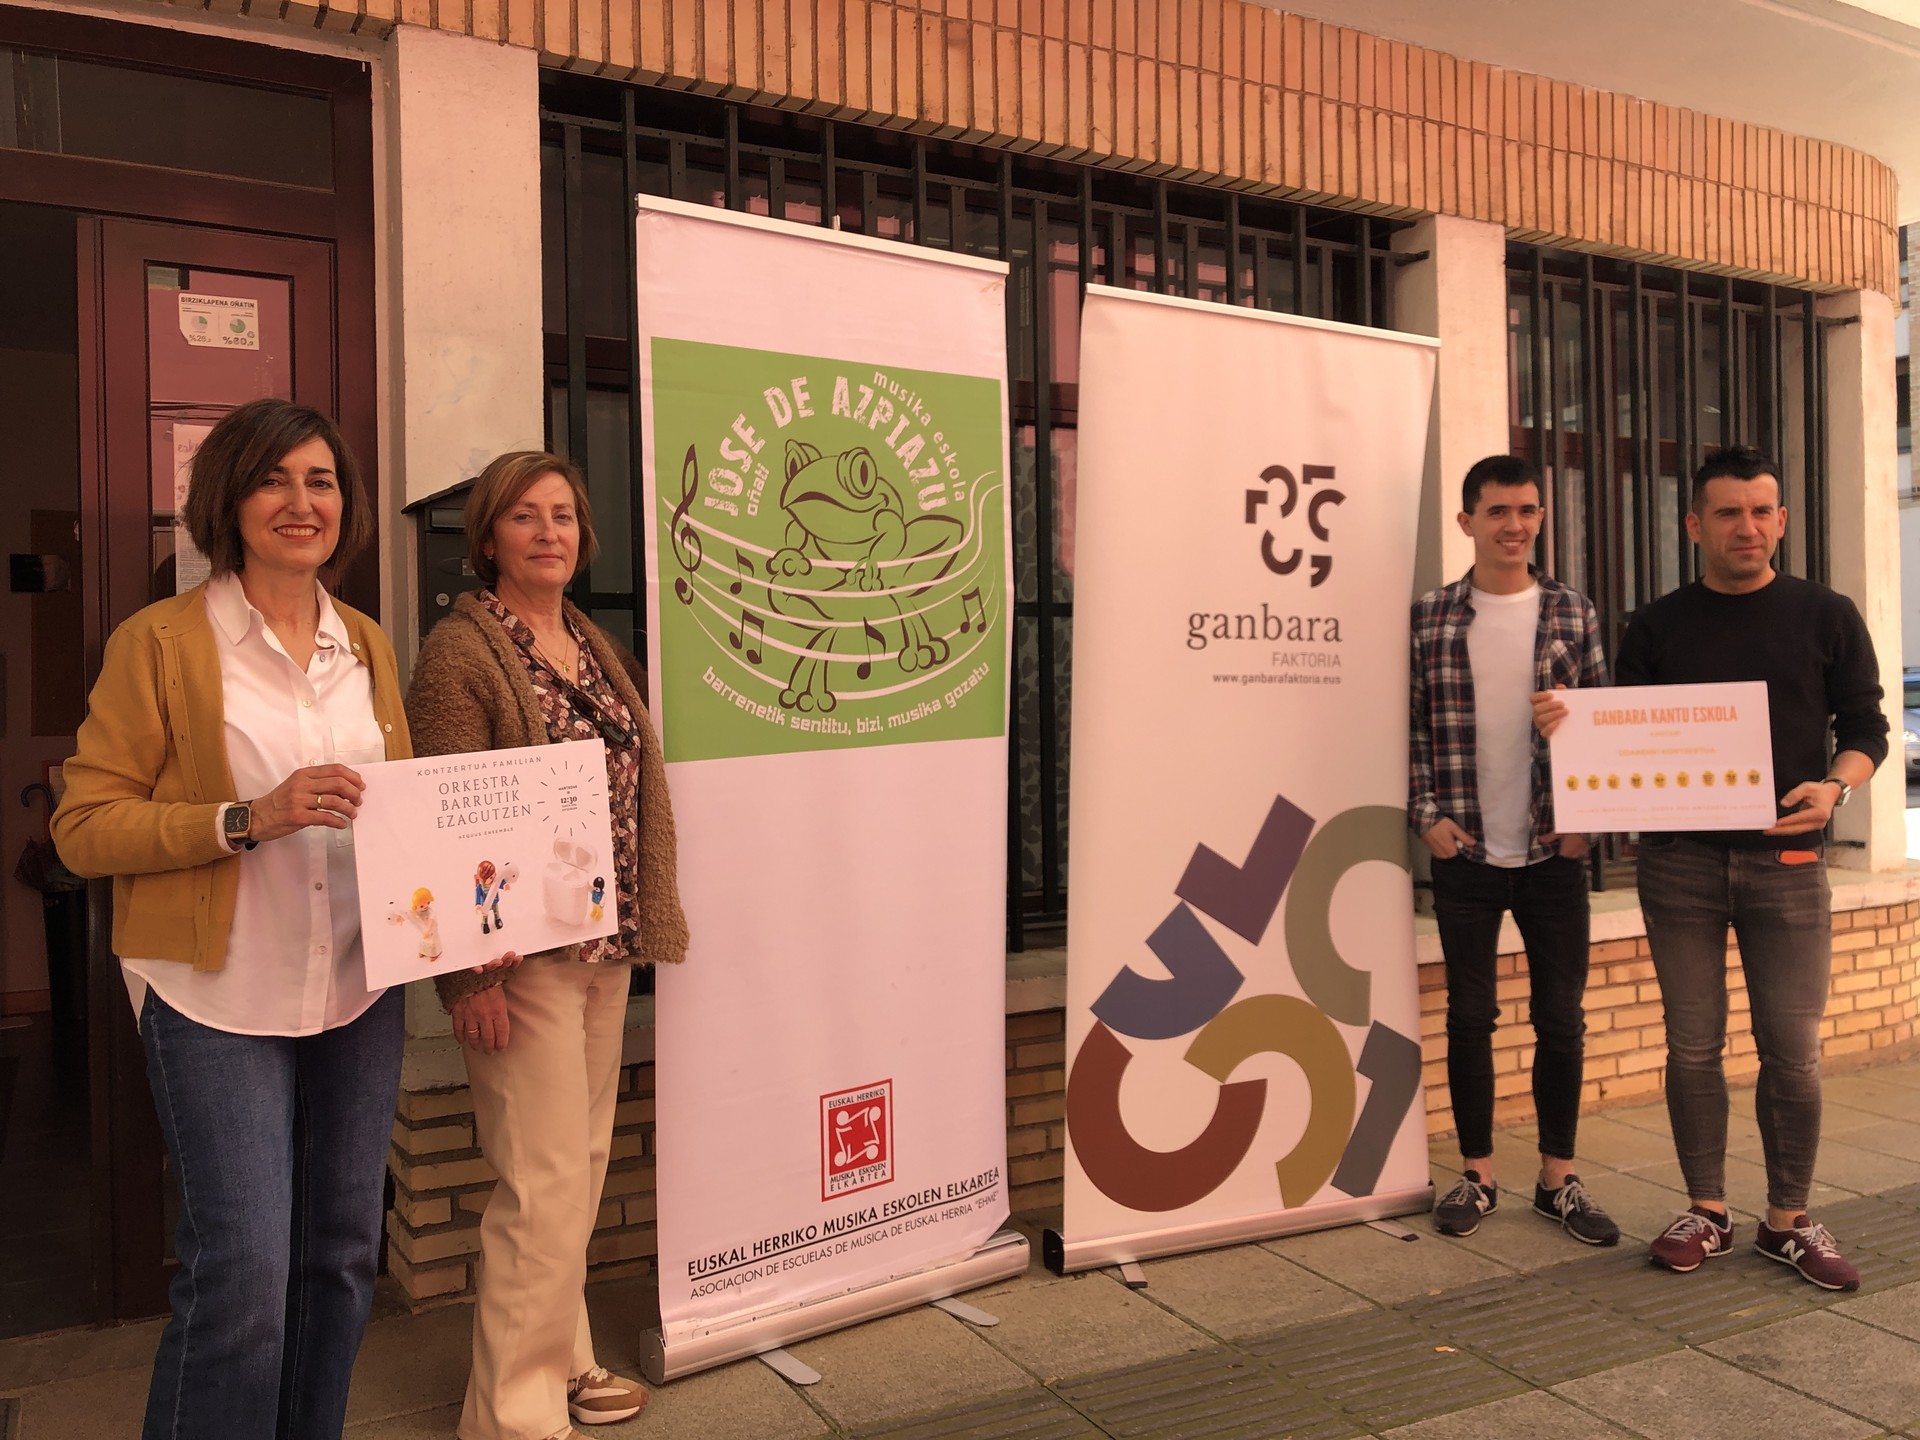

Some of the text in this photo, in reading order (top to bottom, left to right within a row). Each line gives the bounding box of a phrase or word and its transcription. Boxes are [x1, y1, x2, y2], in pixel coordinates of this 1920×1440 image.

[181, 297, 255, 308] BIRZIKLAPENA OÑATIN
[704, 376, 949, 517] JOSE DE AZPIAZU
[873, 371, 966, 501] musika eskola
[1186, 603, 1343, 650] ganbara
[1272, 652, 1341, 668] FAKTORIA
[1213, 673, 1341, 686] www.ganbarafaktoria.eus
[702, 662, 990, 735] barrenetik sentitu, bizi, musika gozatu
[1593, 705, 1737, 726] GANBARA KANTU ESKOLA
[417, 756, 542, 776] KONTZERTUA FAMILIAN
[438, 774, 520, 795] ORKESTRA
[441, 790, 520, 811] BARRUTIK
[437, 804, 531, 829] EZAGUTZEN
[484, 827, 513, 835] ENSEMBLE
[829, 1088, 885, 1108] EUSKAL HERRIKO
[830, 1162, 886, 1183] MUSIKA ESKOLEN
[830, 1170, 886, 1192] ELKARTEA
[688, 1167, 999, 1276] EUSKAL HERRIKO MUSIKA ESKOLEN ELKARTEA
[690, 1267, 763, 1299] ASOCIACION
[766, 1262, 779, 1276] DE
[783, 1246, 832, 1270] ESCUELAS
[835, 1241, 848, 1254] DE
[850, 1230, 888, 1250] MUSICA
[891, 1224, 902, 1236] DE
[905, 1213, 939, 1232] EUSKAL
[942, 1204, 973, 1221] HERRIA
